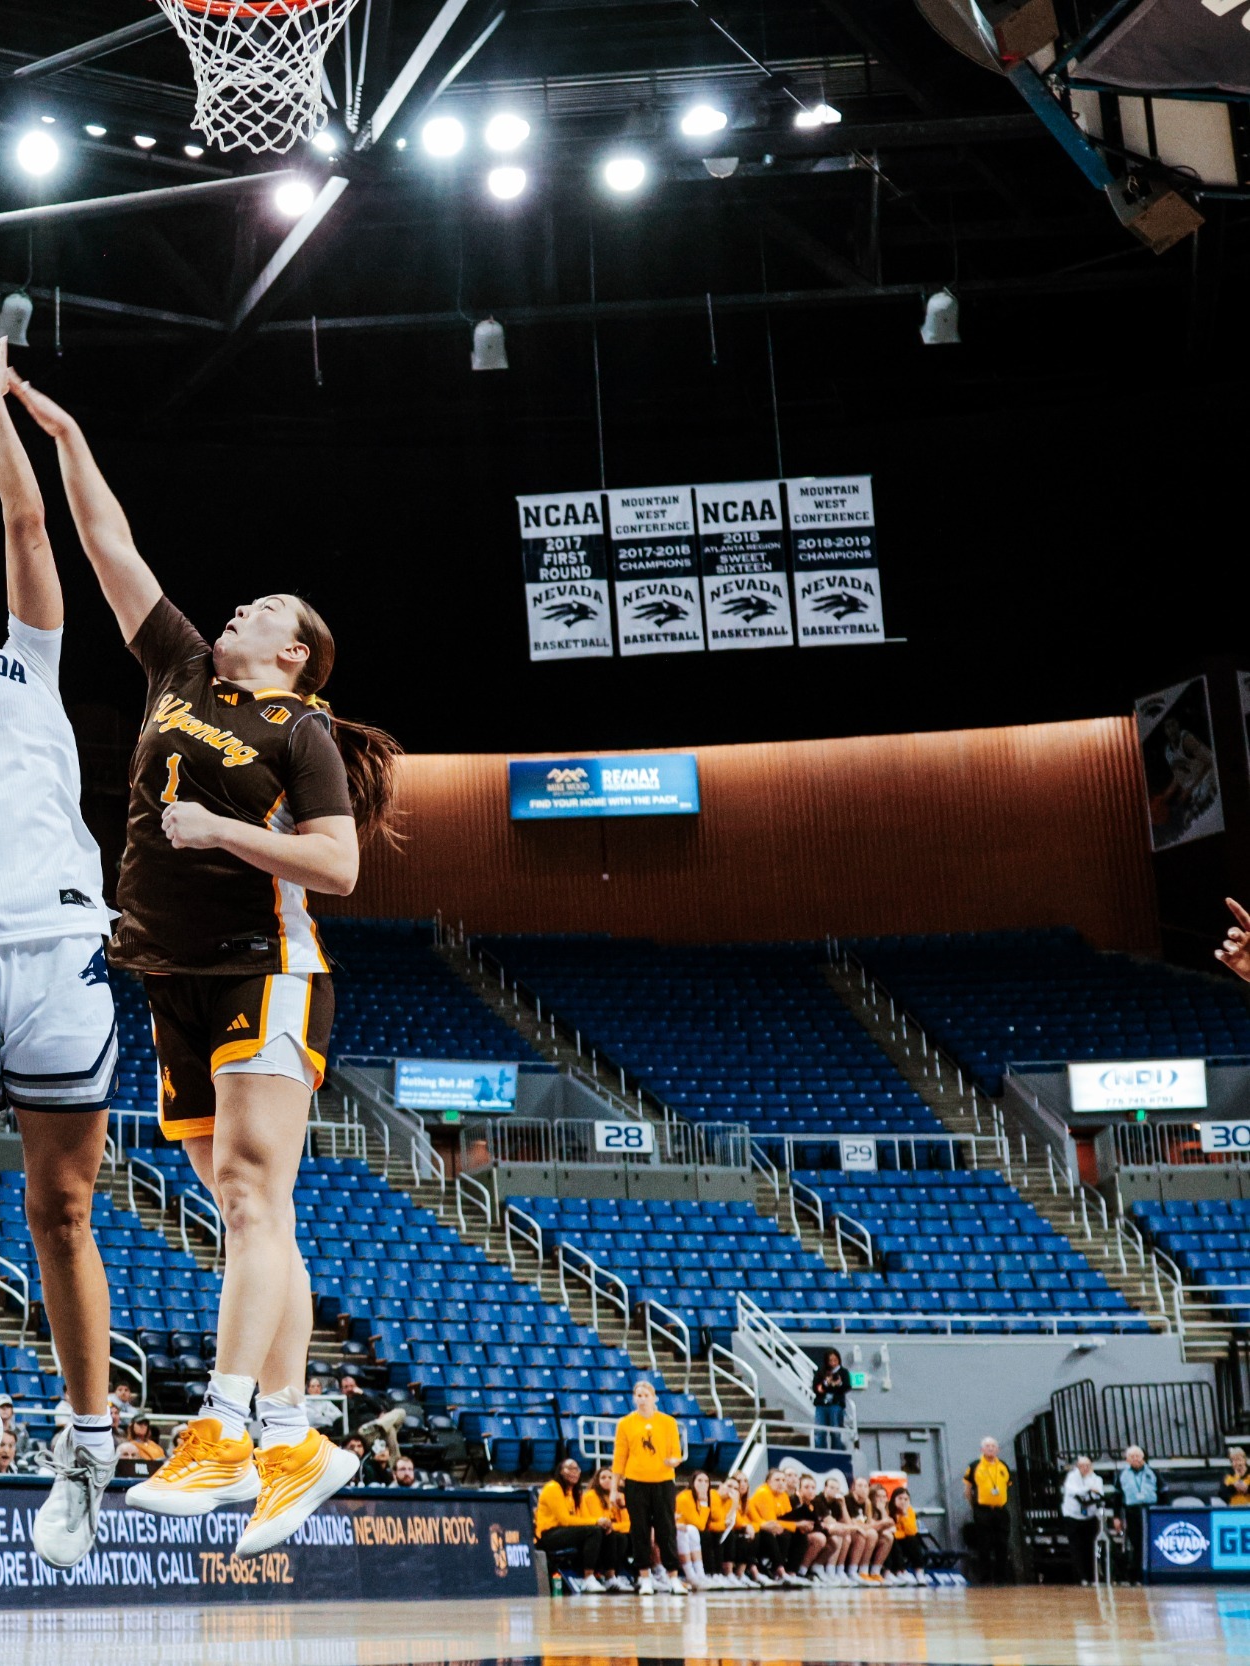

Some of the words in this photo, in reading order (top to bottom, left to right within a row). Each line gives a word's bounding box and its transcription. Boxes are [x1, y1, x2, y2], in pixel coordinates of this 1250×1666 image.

[800, 484, 860, 497] MOUNTAIN
[621, 495, 680, 508] MOUNTAIN
[814, 499, 847, 509] WEST
[523, 502, 600, 528] NCAA
[635, 509, 668, 520] WEST
[701, 498, 777, 524] NCAA
[794, 510, 870, 523] CONFERENCE
[615, 521, 690, 535] CONFERENCE
[545, 536, 582, 551] 2017
[722, 531, 760, 544] 2018
[797, 536, 871, 549] 2018-2019
[543, 551, 587, 566] FIRST
[618, 545, 691, 559] 2017-2018
[719, 552, 767, 564] SWEET
[799, 550, 872, 562] CHAMPIONS
[619, 558, 692, 571] CHAMPIONS
[715, 562, 772, 574] SIXTEEN
[539, 565, 592, 581] ROUND
[622, 583, 695, 606] NEVADA
[710, 578, 783, 601] NEVADA
[801, 576, 875, 599] NEVADA
[533, 584, 603, 608] NEVADA
[711, 625, 789, 639] BASKETBALL
[802, 622, 880, 636] BASKETBALL
[534, 638, 610, 651] BASKETBALL
[623, 630, 700, 645] BASKETBALL
[153, 693, 259, 768] Wyoming
[161, 752, 182, 804] 1
[602, 768, 659, 784] RE/MAX
[529, 798, 551, 809] FIND
[553, 798, 578, 808] YOUR
[580, 797, 606, 807] HOME
[608, 796, 631, 806] WITH
[633, 796, 650, 805] THE
[652, 795, 678, 804] PACK
[605, 1126, 644, 1148] 28
[1211, 1125, 1250, 1148] 30
[845, 1146, 873, 1161] 29
[11, 1508, 25, 1543] A
[97, 1511, 158, 1544] STATES
[160, 1514, 203, 1544] ARMY
[353, 1516, 405, 1546] NEVADA
[406, 1517, 440, 1545] ARMY
[442, 1518, 479, 1545] ROTC.
[1157, 1535, 1208, 1551] NEVADA
[506, 1544, 531, 1567] ROTC
[157, 1552, 199, 1585] CALL
